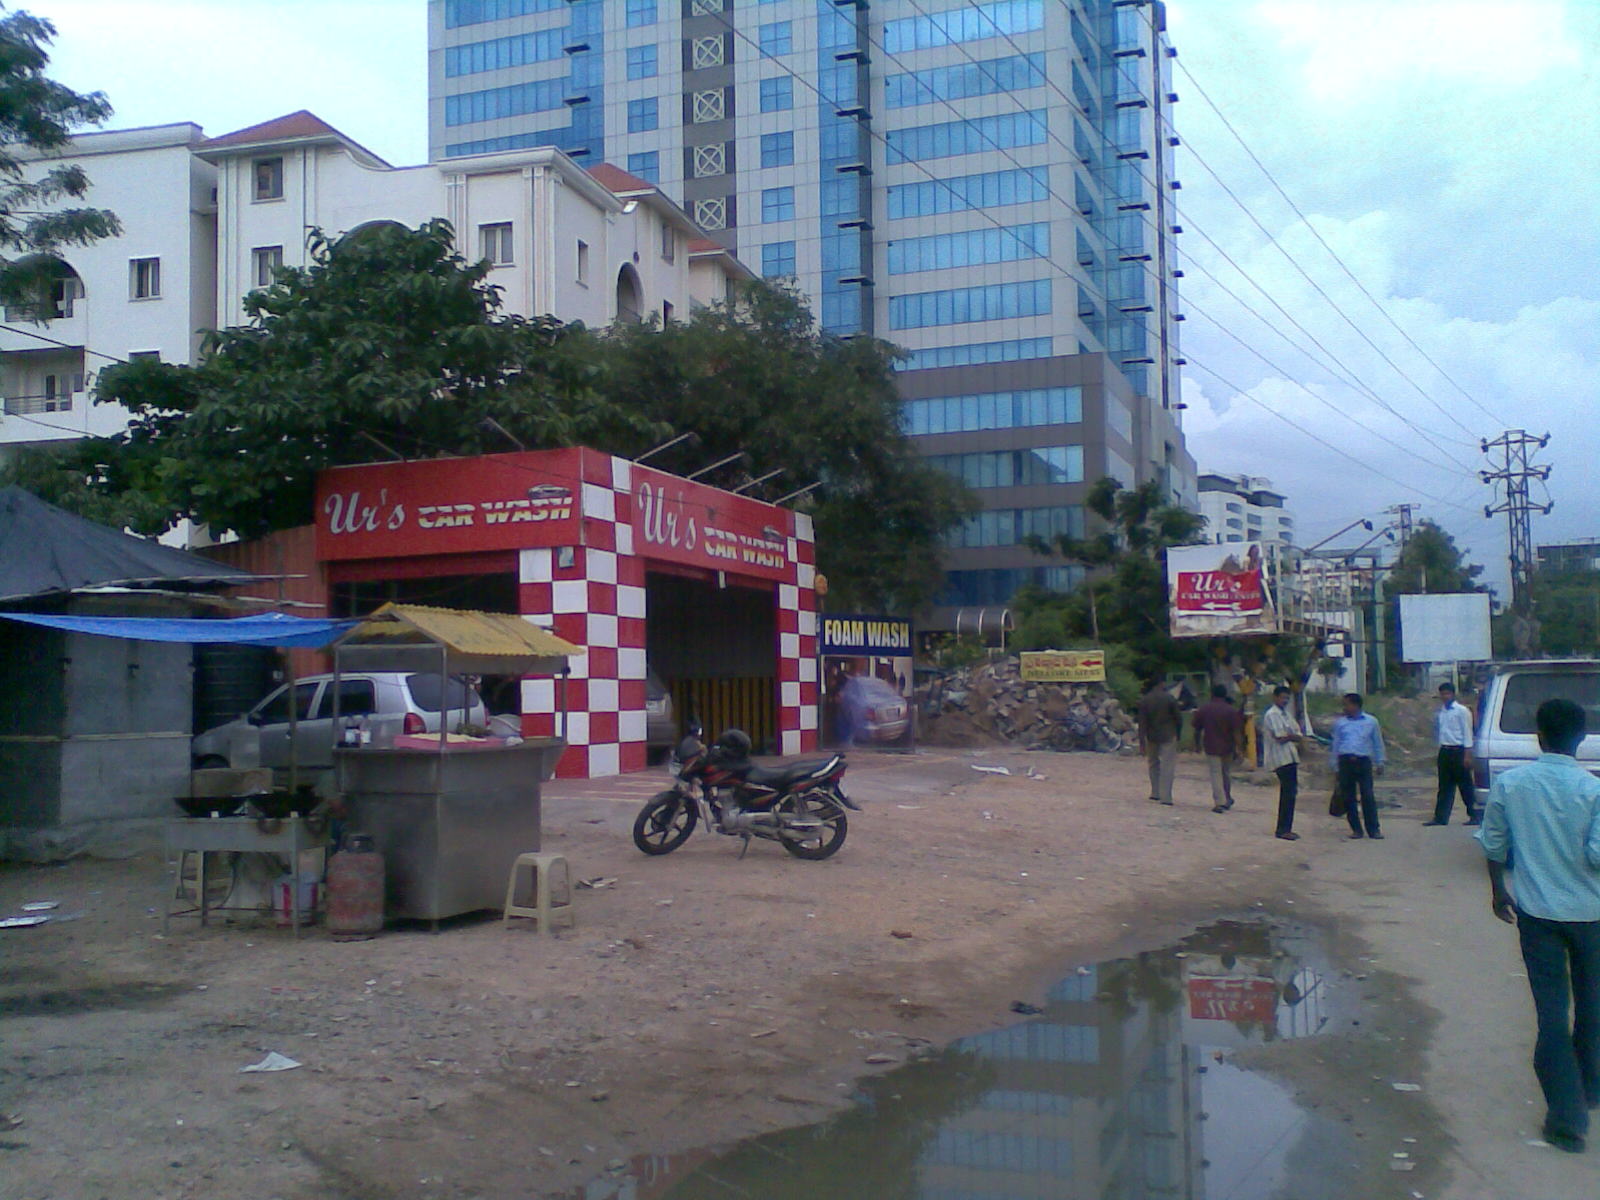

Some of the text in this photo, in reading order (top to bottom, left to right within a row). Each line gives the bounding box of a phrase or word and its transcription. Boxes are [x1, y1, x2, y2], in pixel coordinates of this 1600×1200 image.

[324, 488, 573, 534] Ur's CAR WASH
[638, 482, 785, 569] Ur's CAR WASH
[824, 619, 910, 648] FOAM WASH
